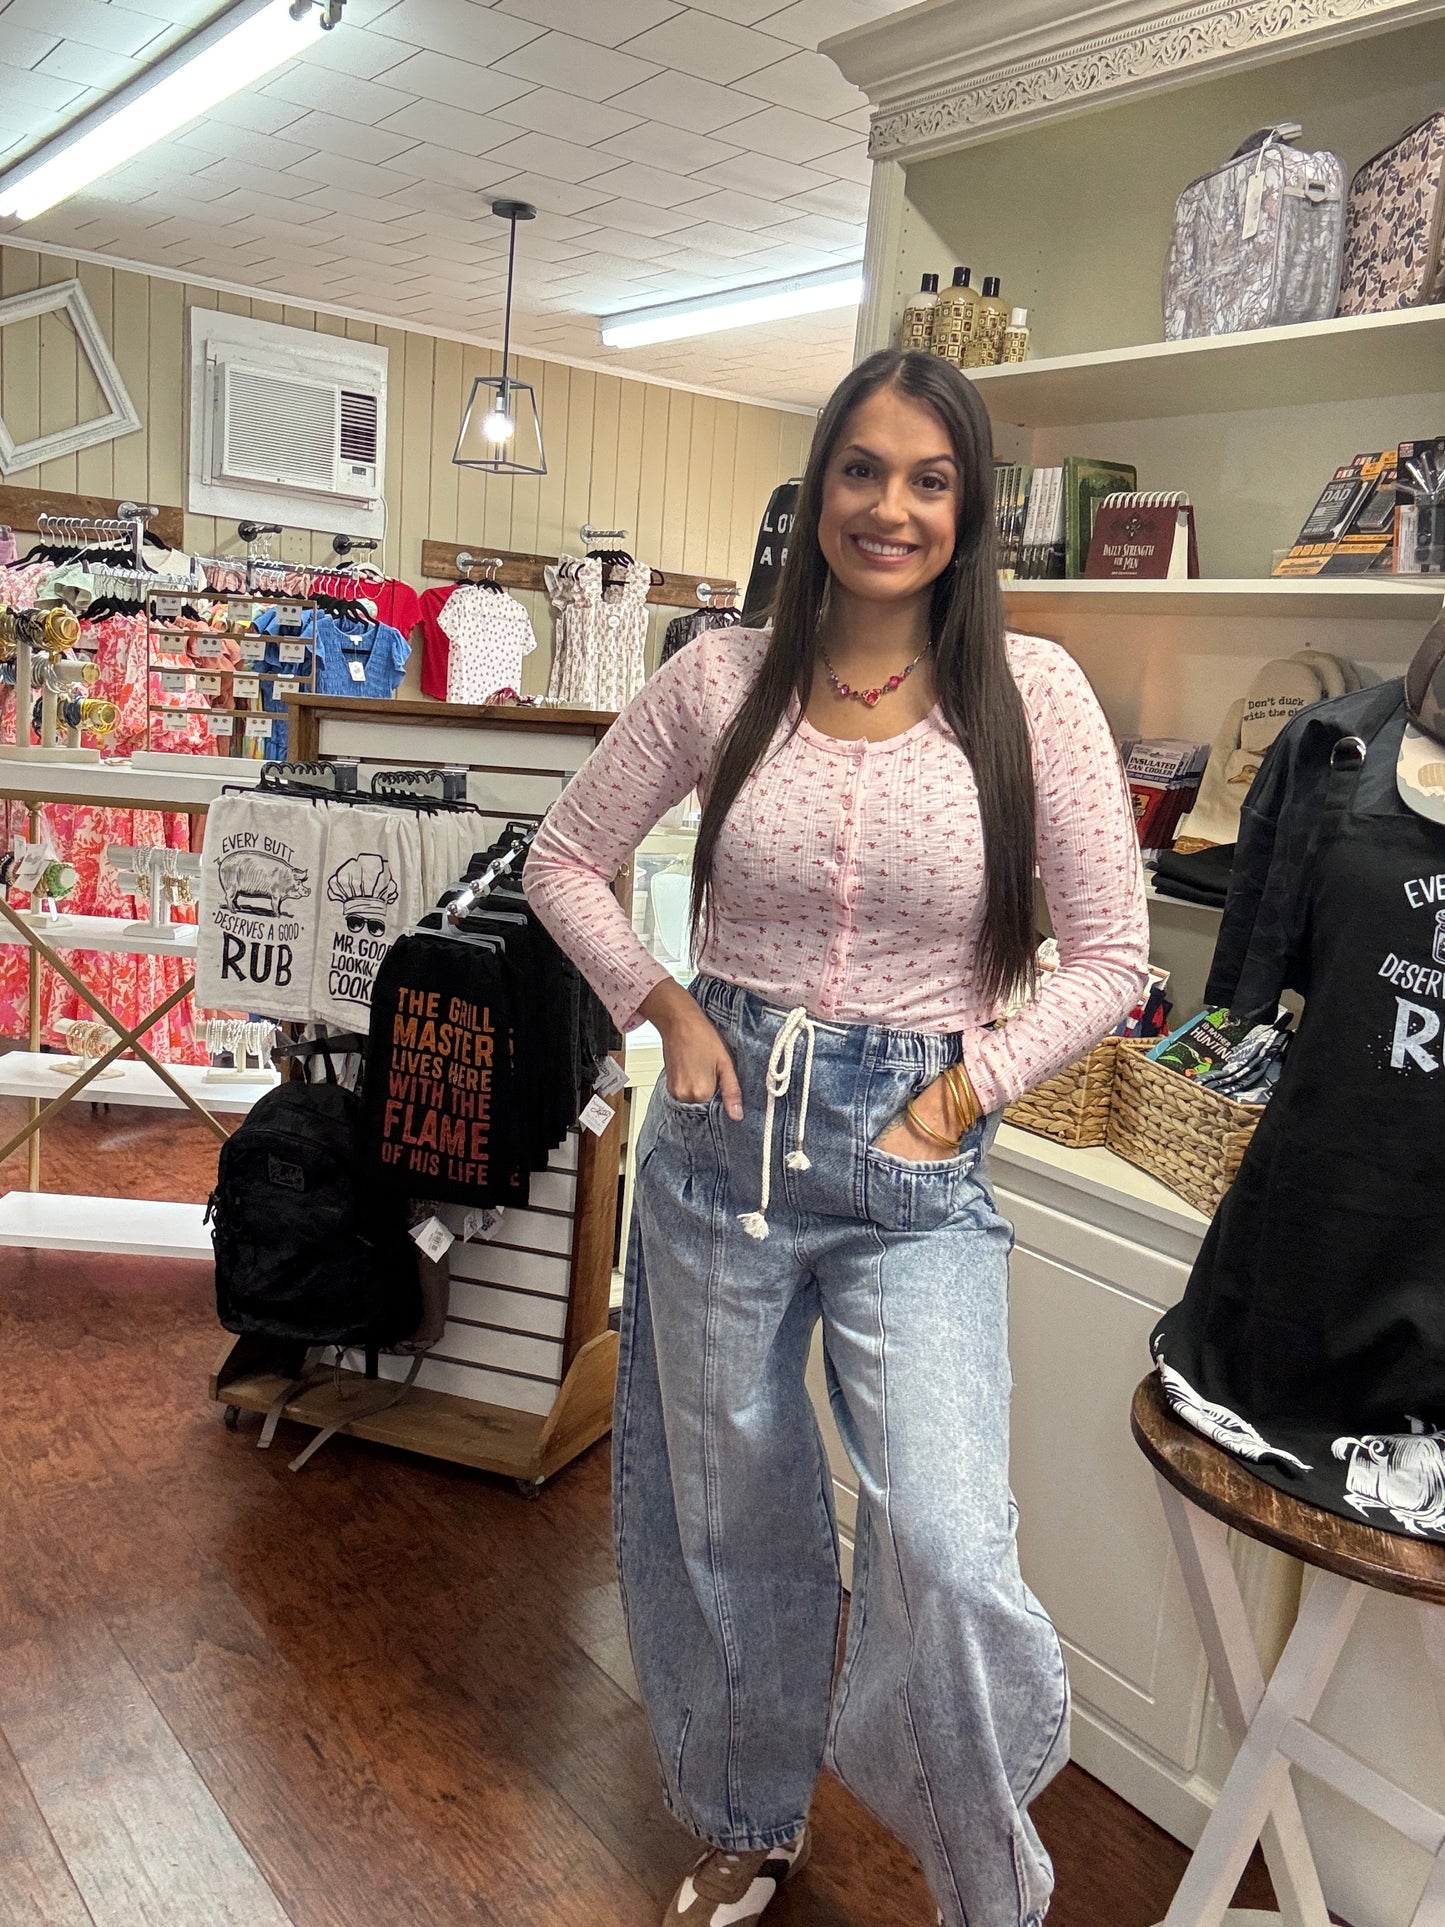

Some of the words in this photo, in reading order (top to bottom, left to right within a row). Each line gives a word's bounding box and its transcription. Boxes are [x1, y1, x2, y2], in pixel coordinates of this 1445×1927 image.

[1320, 489, 1351, 502] DAD
[1122, 544, 1155, 557] STRENGTH
[1123, 558, 1139, 570] MEN
[1243, 710, 1266, 721] with
[1268, 709, 1286, 717] the
[1248, 698, 1276, 710] Don't
[1278, 696, 1304, 706] duck
[1127, 763, 1143, 771] CAN
[1144, 766, 1173, 776] COOLER
[1130, 757, 1177, 770] INSULATED
[222, 832, 259, 854] EVERY
[264, 836, 295, 862] BUTT
[214, 911, 265, 939] DESERVES
[267, 924, 274, 941] A
[278, 923, 300, 942] GOOD
[333, 932, 355, 955] MR.
[221, 931, 293, 987] RUB
[331, 952, 378, 977] LOOKIN'
[1378, 952, 1445, 1000] DESER
[398, 987, 441, 1018] THE
[448, 997, 495, 1033] GRILL
[393, 1013, 494, 1067] MASTER
[1209, 1027, 1232, 1048] RATHER
[391, 1047, 443, 1080] LIVES
[447, 1061, 493, 1092] HERE
[388, 1070, 444, 1110] WITH
[451, 1087, 491, 1121] THE
[383, 1099, 491, 1161] FLAME
[381, 1141, 404, 1165] OF
[409, 1149, 440, 1176] HIS
[448, 1158, 488, 1186] LIFE
